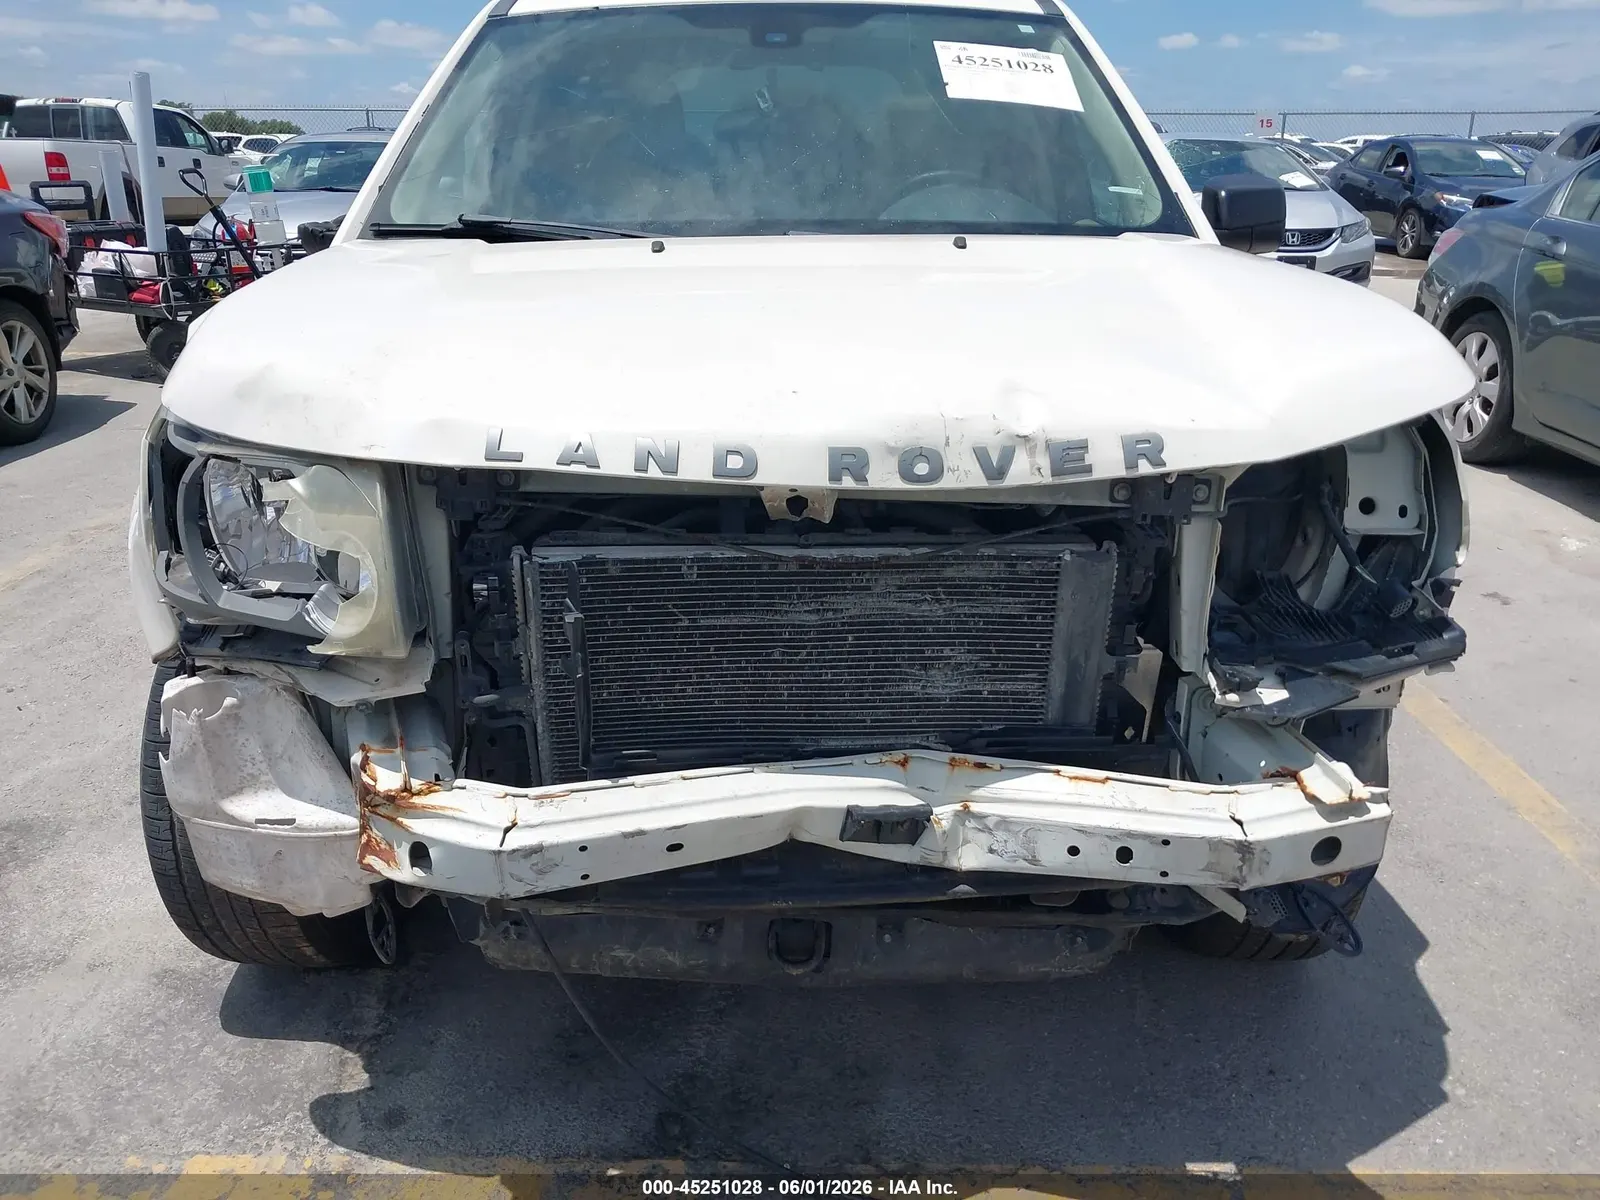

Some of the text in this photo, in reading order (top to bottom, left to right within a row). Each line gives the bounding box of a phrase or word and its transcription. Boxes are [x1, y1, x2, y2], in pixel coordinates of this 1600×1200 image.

[951, 54, 1054, 74] 45251028
[1259, 118, 1273, 128] 15
[484, 427, 1166, 486] LAND ROVER
